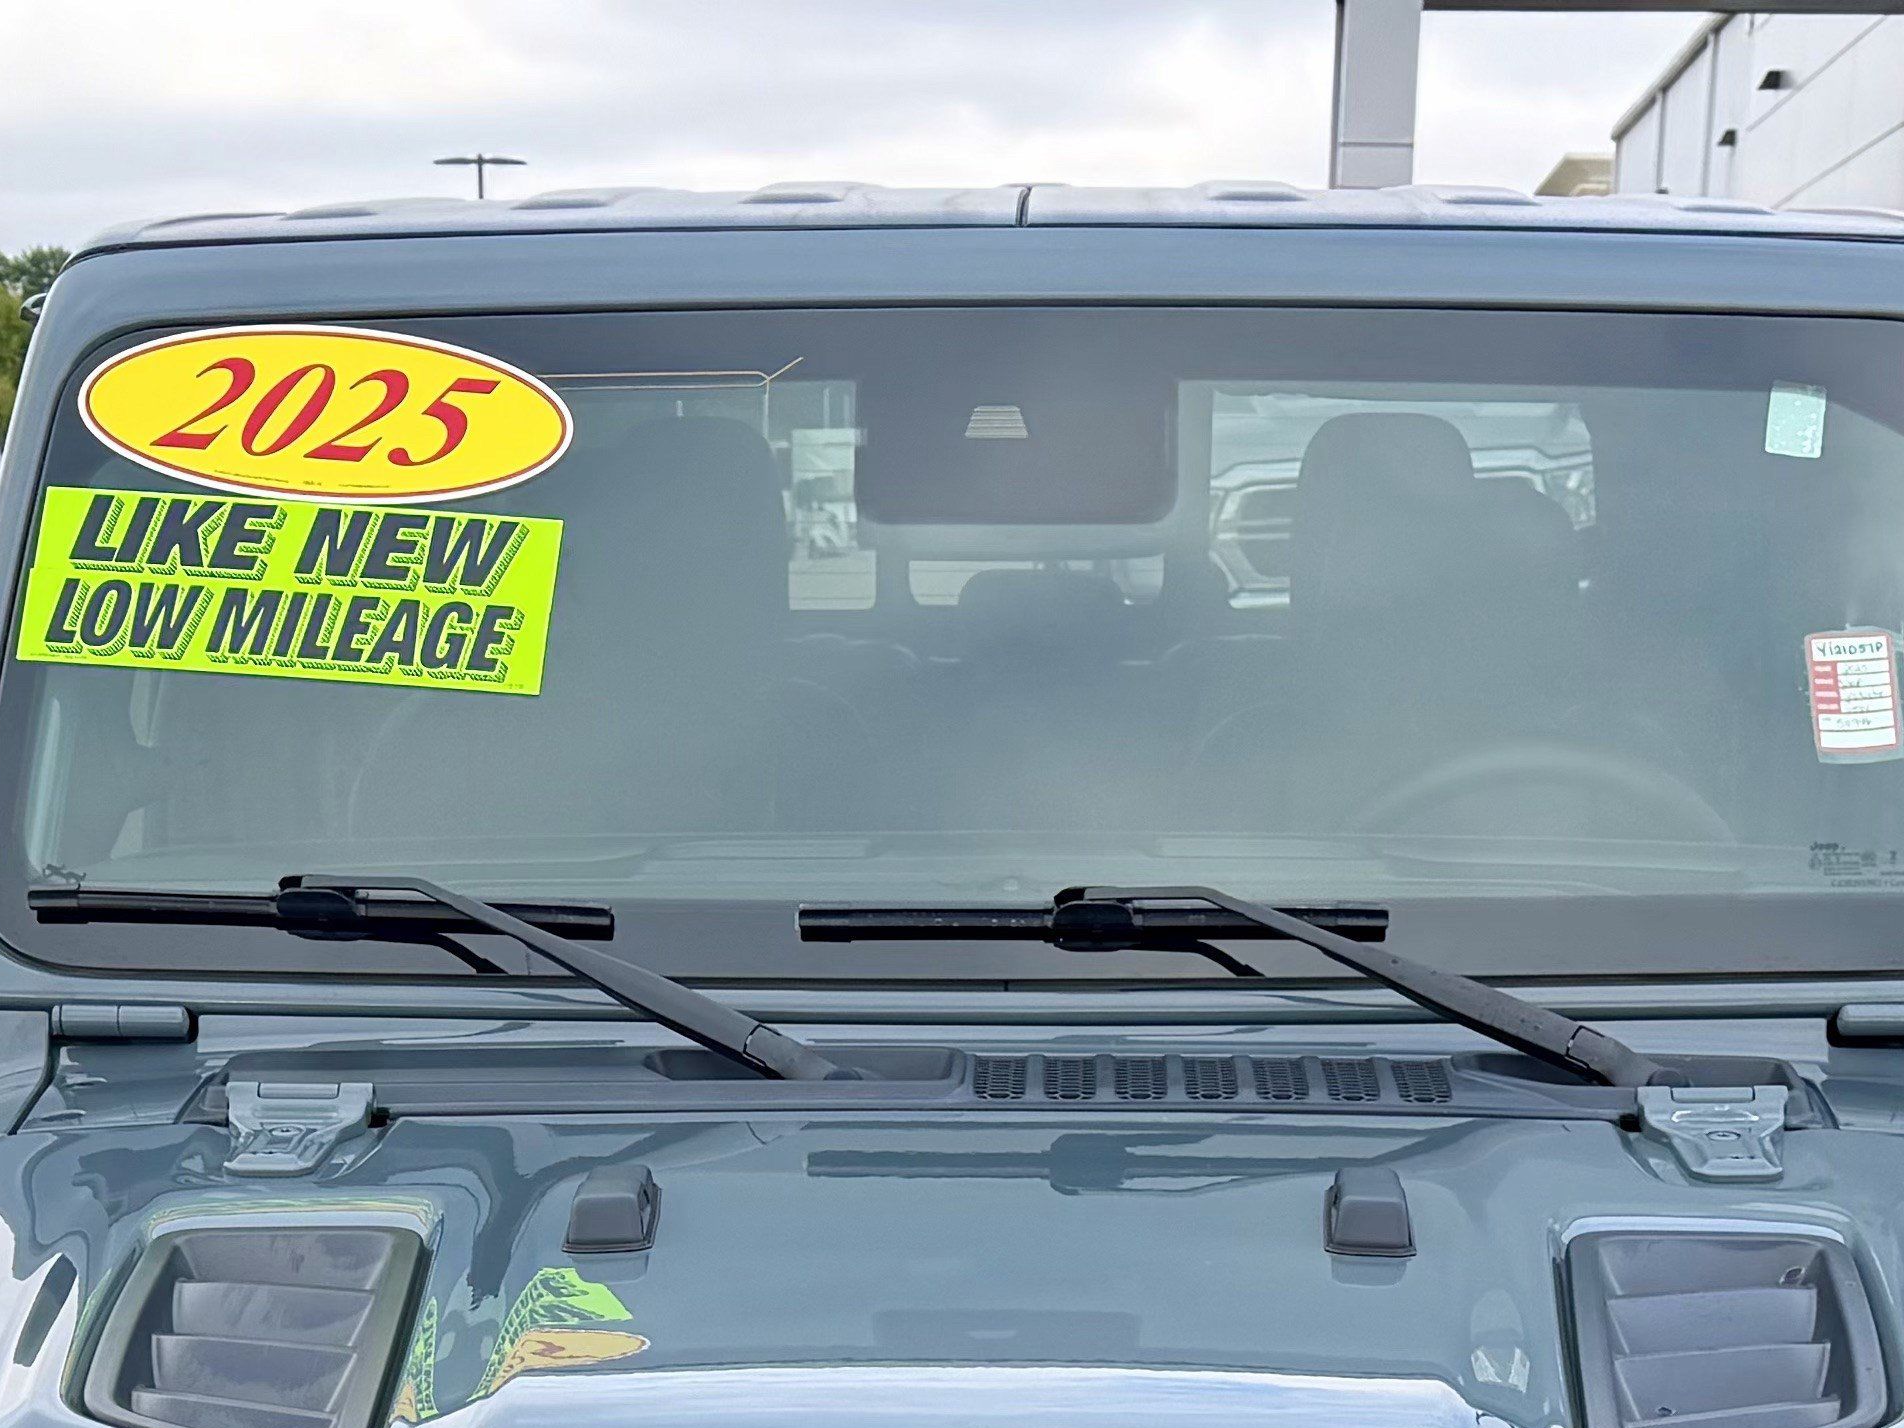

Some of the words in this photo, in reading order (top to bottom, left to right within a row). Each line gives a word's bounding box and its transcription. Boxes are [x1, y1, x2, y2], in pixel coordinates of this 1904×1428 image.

[150, 356, 501, 467] 2025
[70, 494, 289, 581] LIKE
[294, 507, 531, 597] NEW
[44, 578, 215, 661] LOW
[206, 587, 525, 684] MILEAGE
